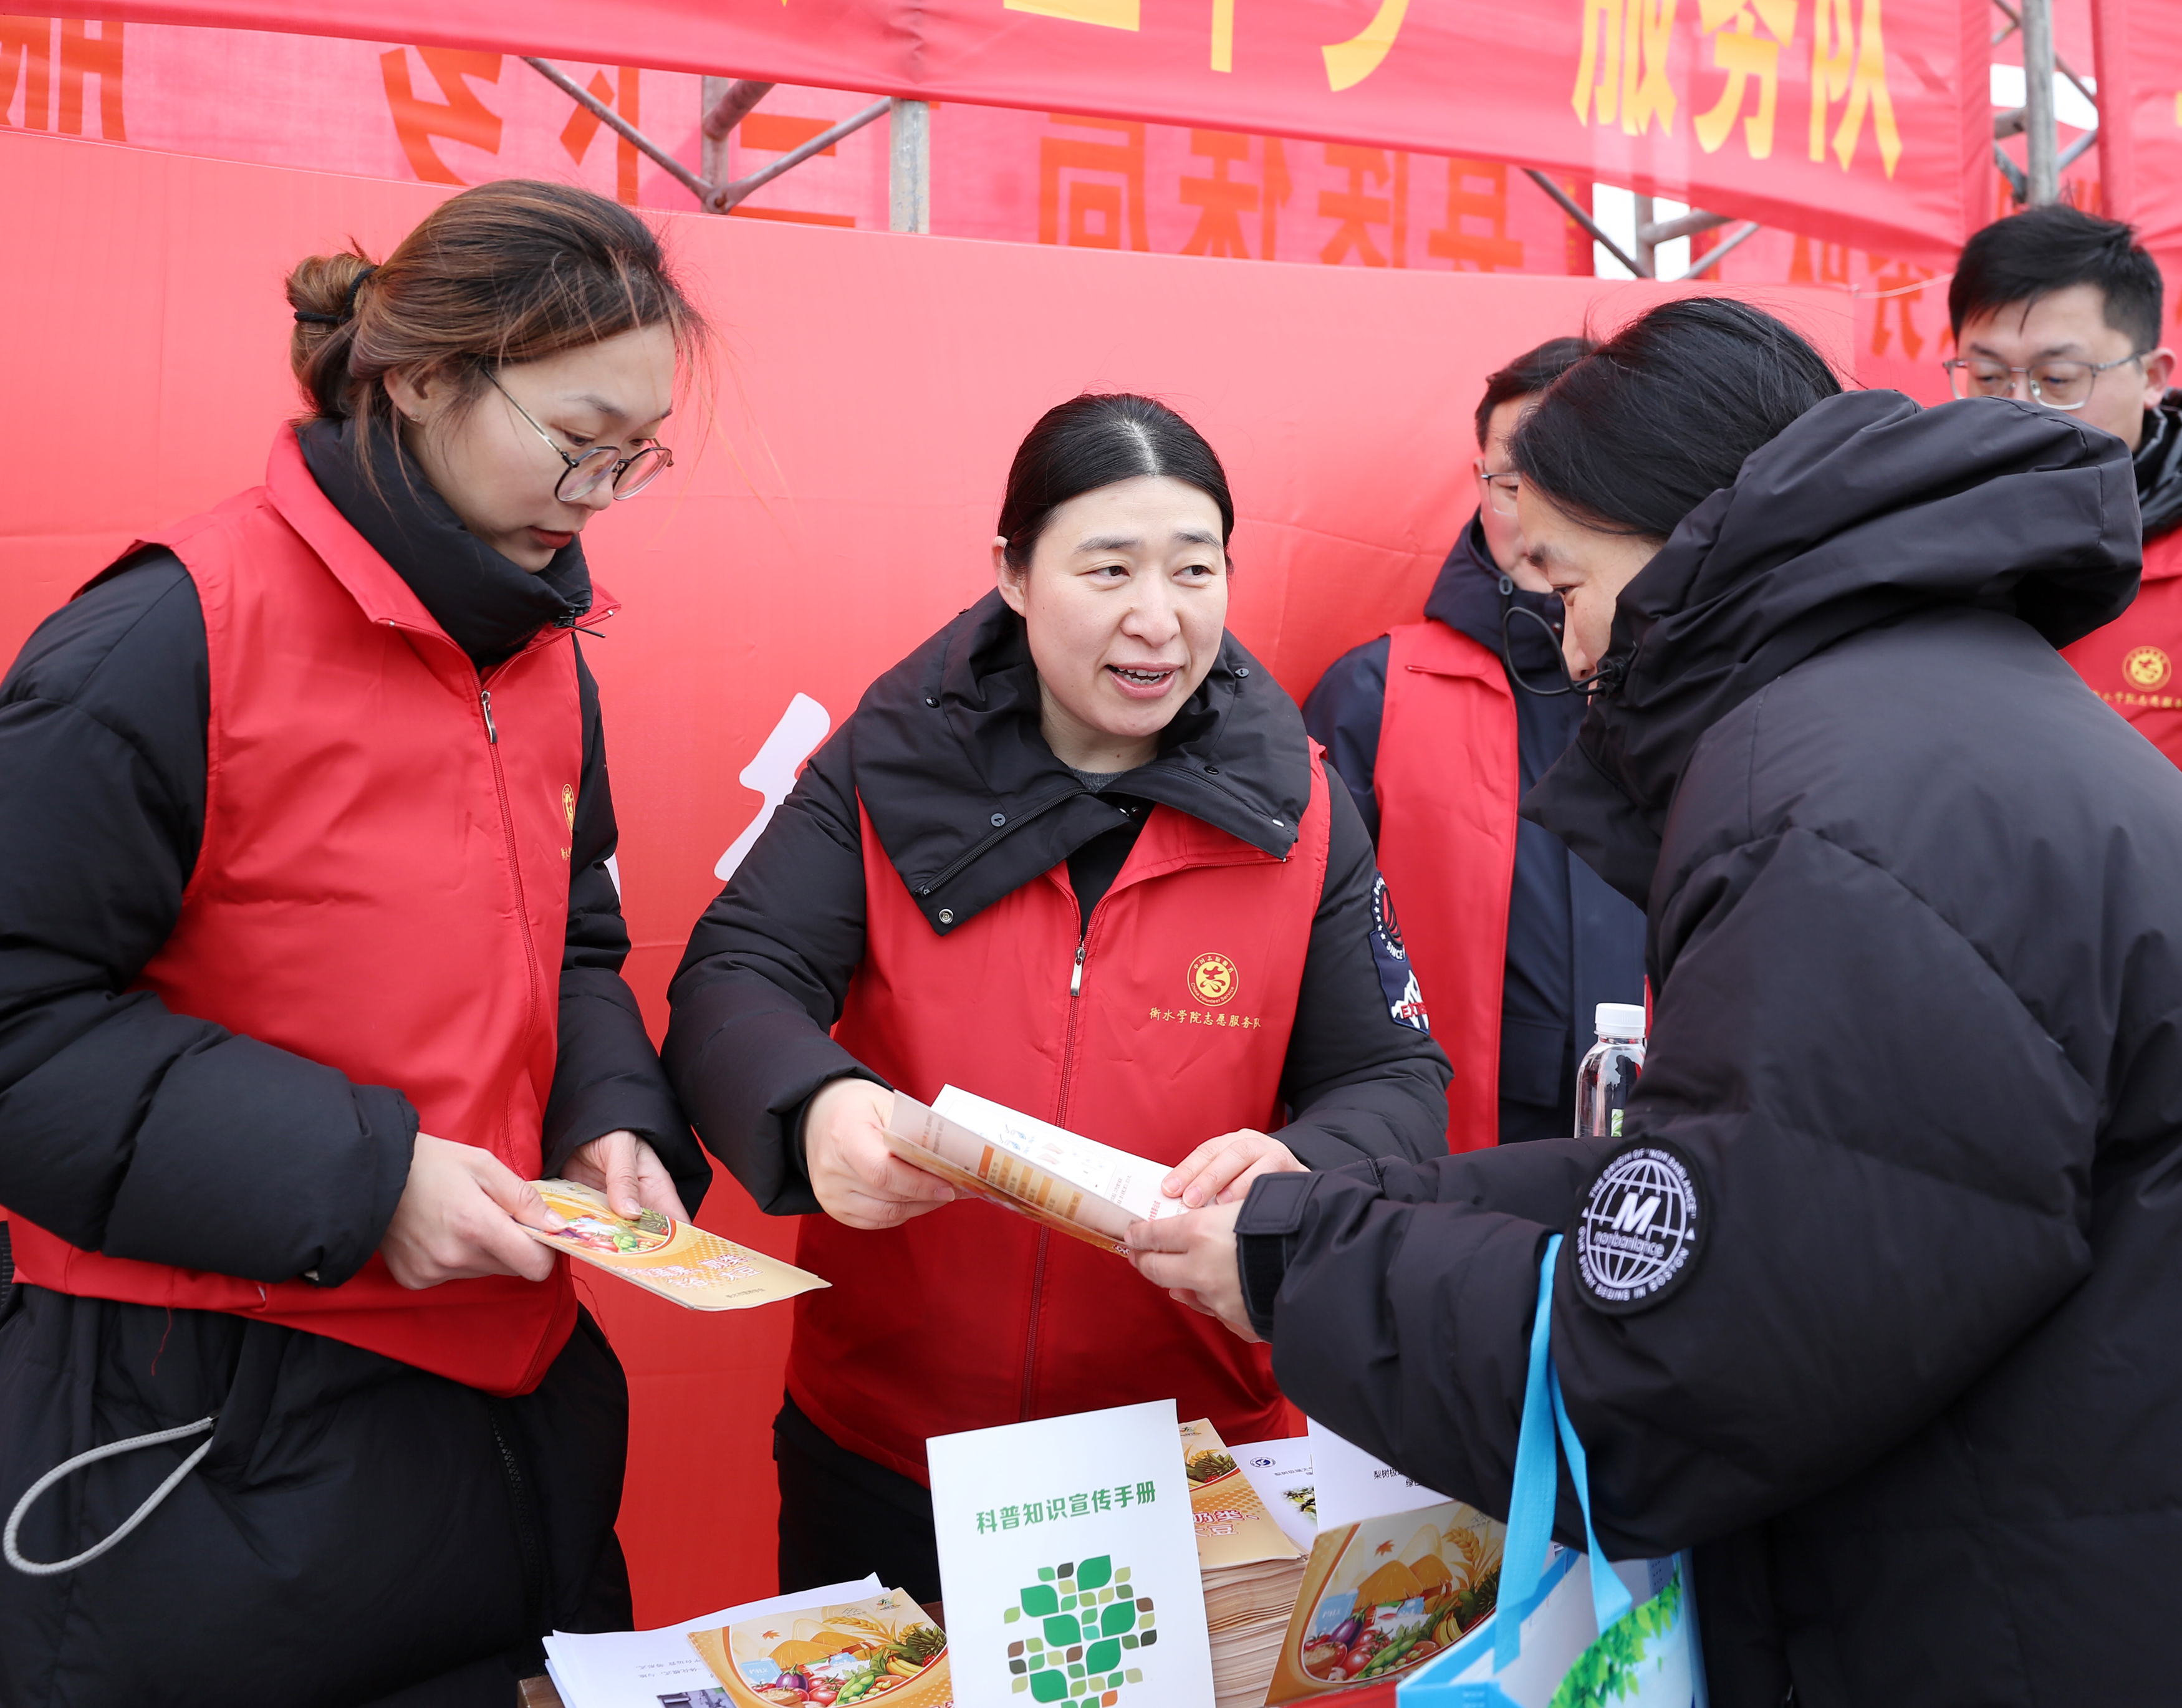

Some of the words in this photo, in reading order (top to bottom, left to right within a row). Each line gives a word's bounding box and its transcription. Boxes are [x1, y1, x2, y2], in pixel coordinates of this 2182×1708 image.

[1387, 941, 1403, 959] SINCE
[1191, 982, 1200, 996] China
[1199, 994, 1221, 1004] Volunteer
[1220, 986, 1234, 1001] Service
[1149, 1007, 1261, 1029] 衡水学院志愿服务队
[1588, 1176, 1605, 1198] THE
[1603, 1152, 1632, 1179] ORIGIN
[1633, 1148, 1646, 1159] OF
[1611, 1192, 1661, 1235] M
[1577, 1226, 1587, 1254] OUR
[1593, 1231, 1665, 1257] nonbanlance
[1579, 1254, 1597, 1288] STORY
[1648, 1247, 1689, 1292] BOSTON
[1595, 1283, 1630, 1301] BEGINS
[1633, 1285, 1646, 1299] IN
[976, 1480, 1155, 1535] 科普知识宣传手册
